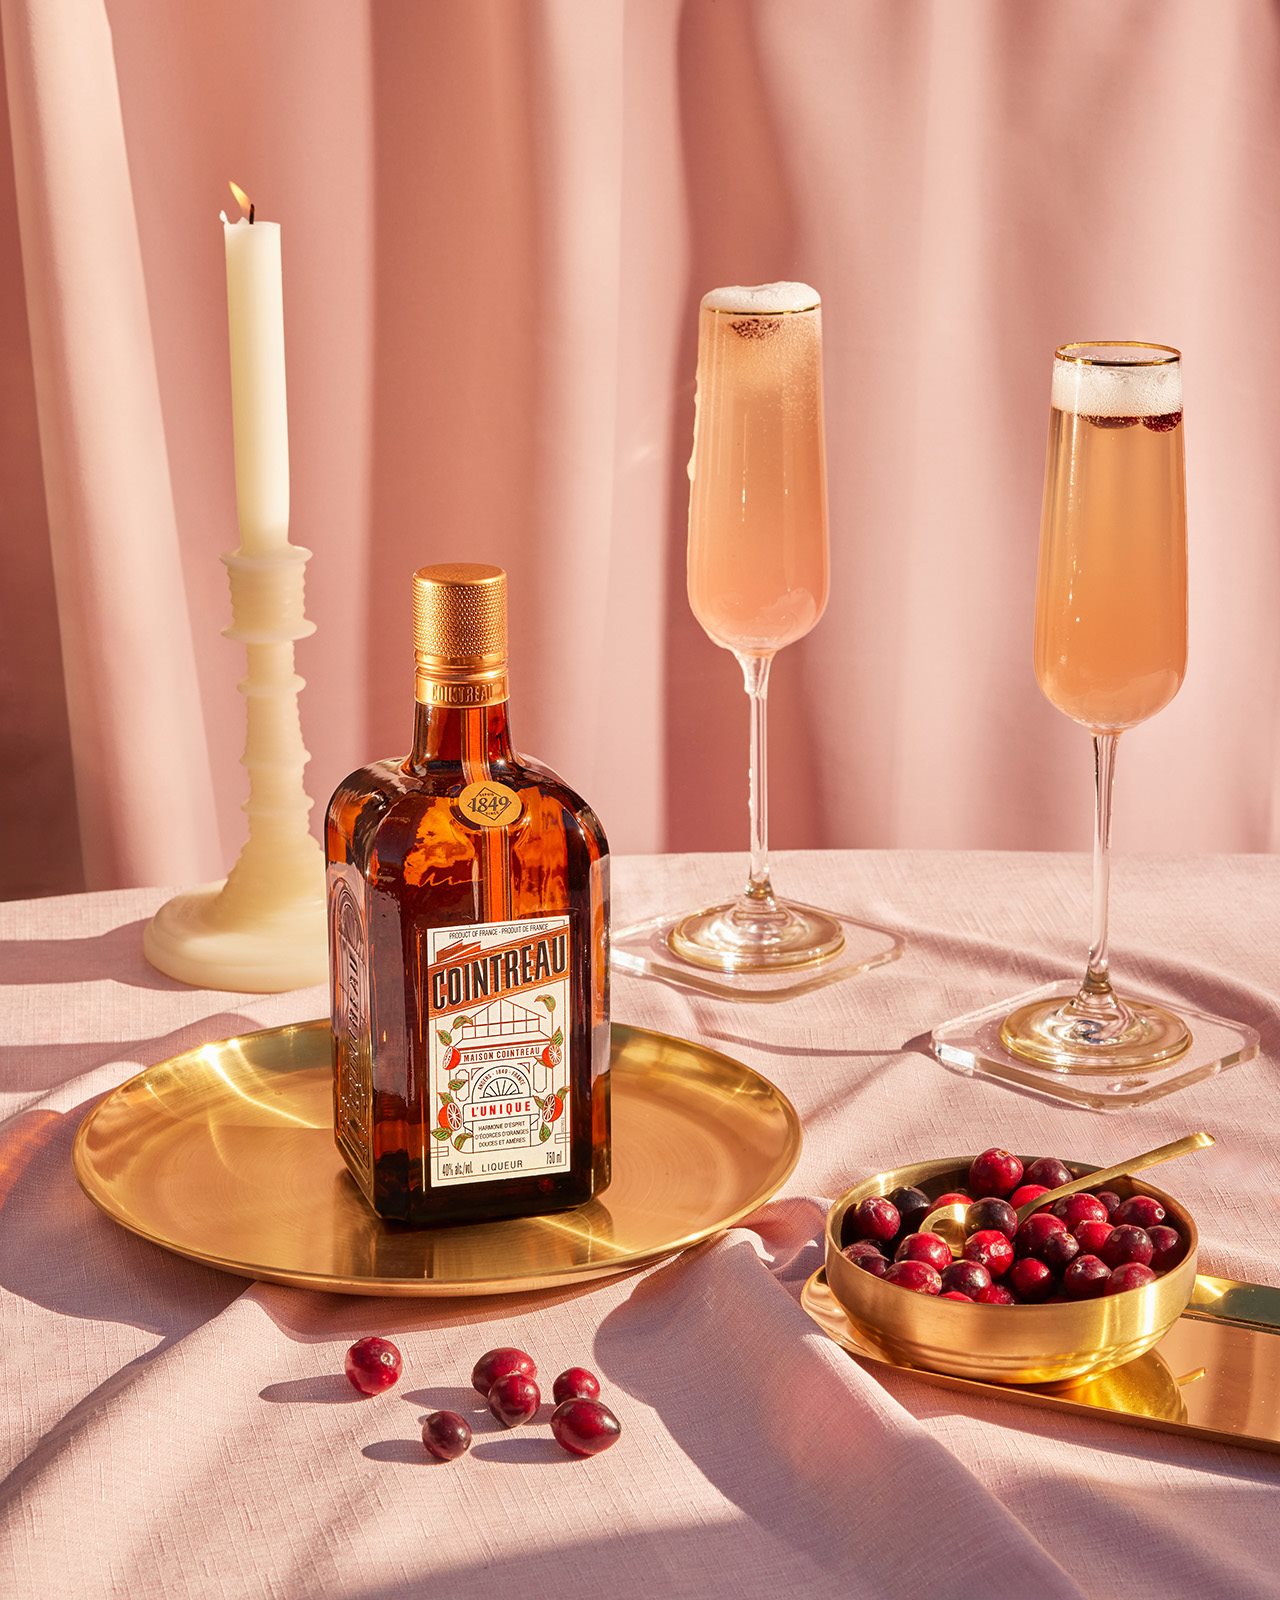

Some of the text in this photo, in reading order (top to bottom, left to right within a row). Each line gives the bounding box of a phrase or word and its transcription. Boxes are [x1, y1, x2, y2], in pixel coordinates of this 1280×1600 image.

[471, 796, 509, 813] 1849
[449, 932, 471, 940] PRODUCT
[479, 929, 498, 937] FRANCE
[501, 926, 522, 935] PRODUIT
[522, 925, 529, 933] DE
[529, 923, 549, 932] FRANCE
[432, 935, 567, 1010] COINTREAU
[463, 1046, 540, 1062] MAISON COINTREAU
[471, 1101, 531, 1118] L'UNIQUE
[478, 1121, 525, 1131] HARMONIE D'ESPRIT
[479, 1140, 498, 1148] DOUCES
[546, 1151, 556, 1165] 750
[442, 1163, 454, 1176] 40%
[481, 1160, 523, 1173] LIQUEUR
